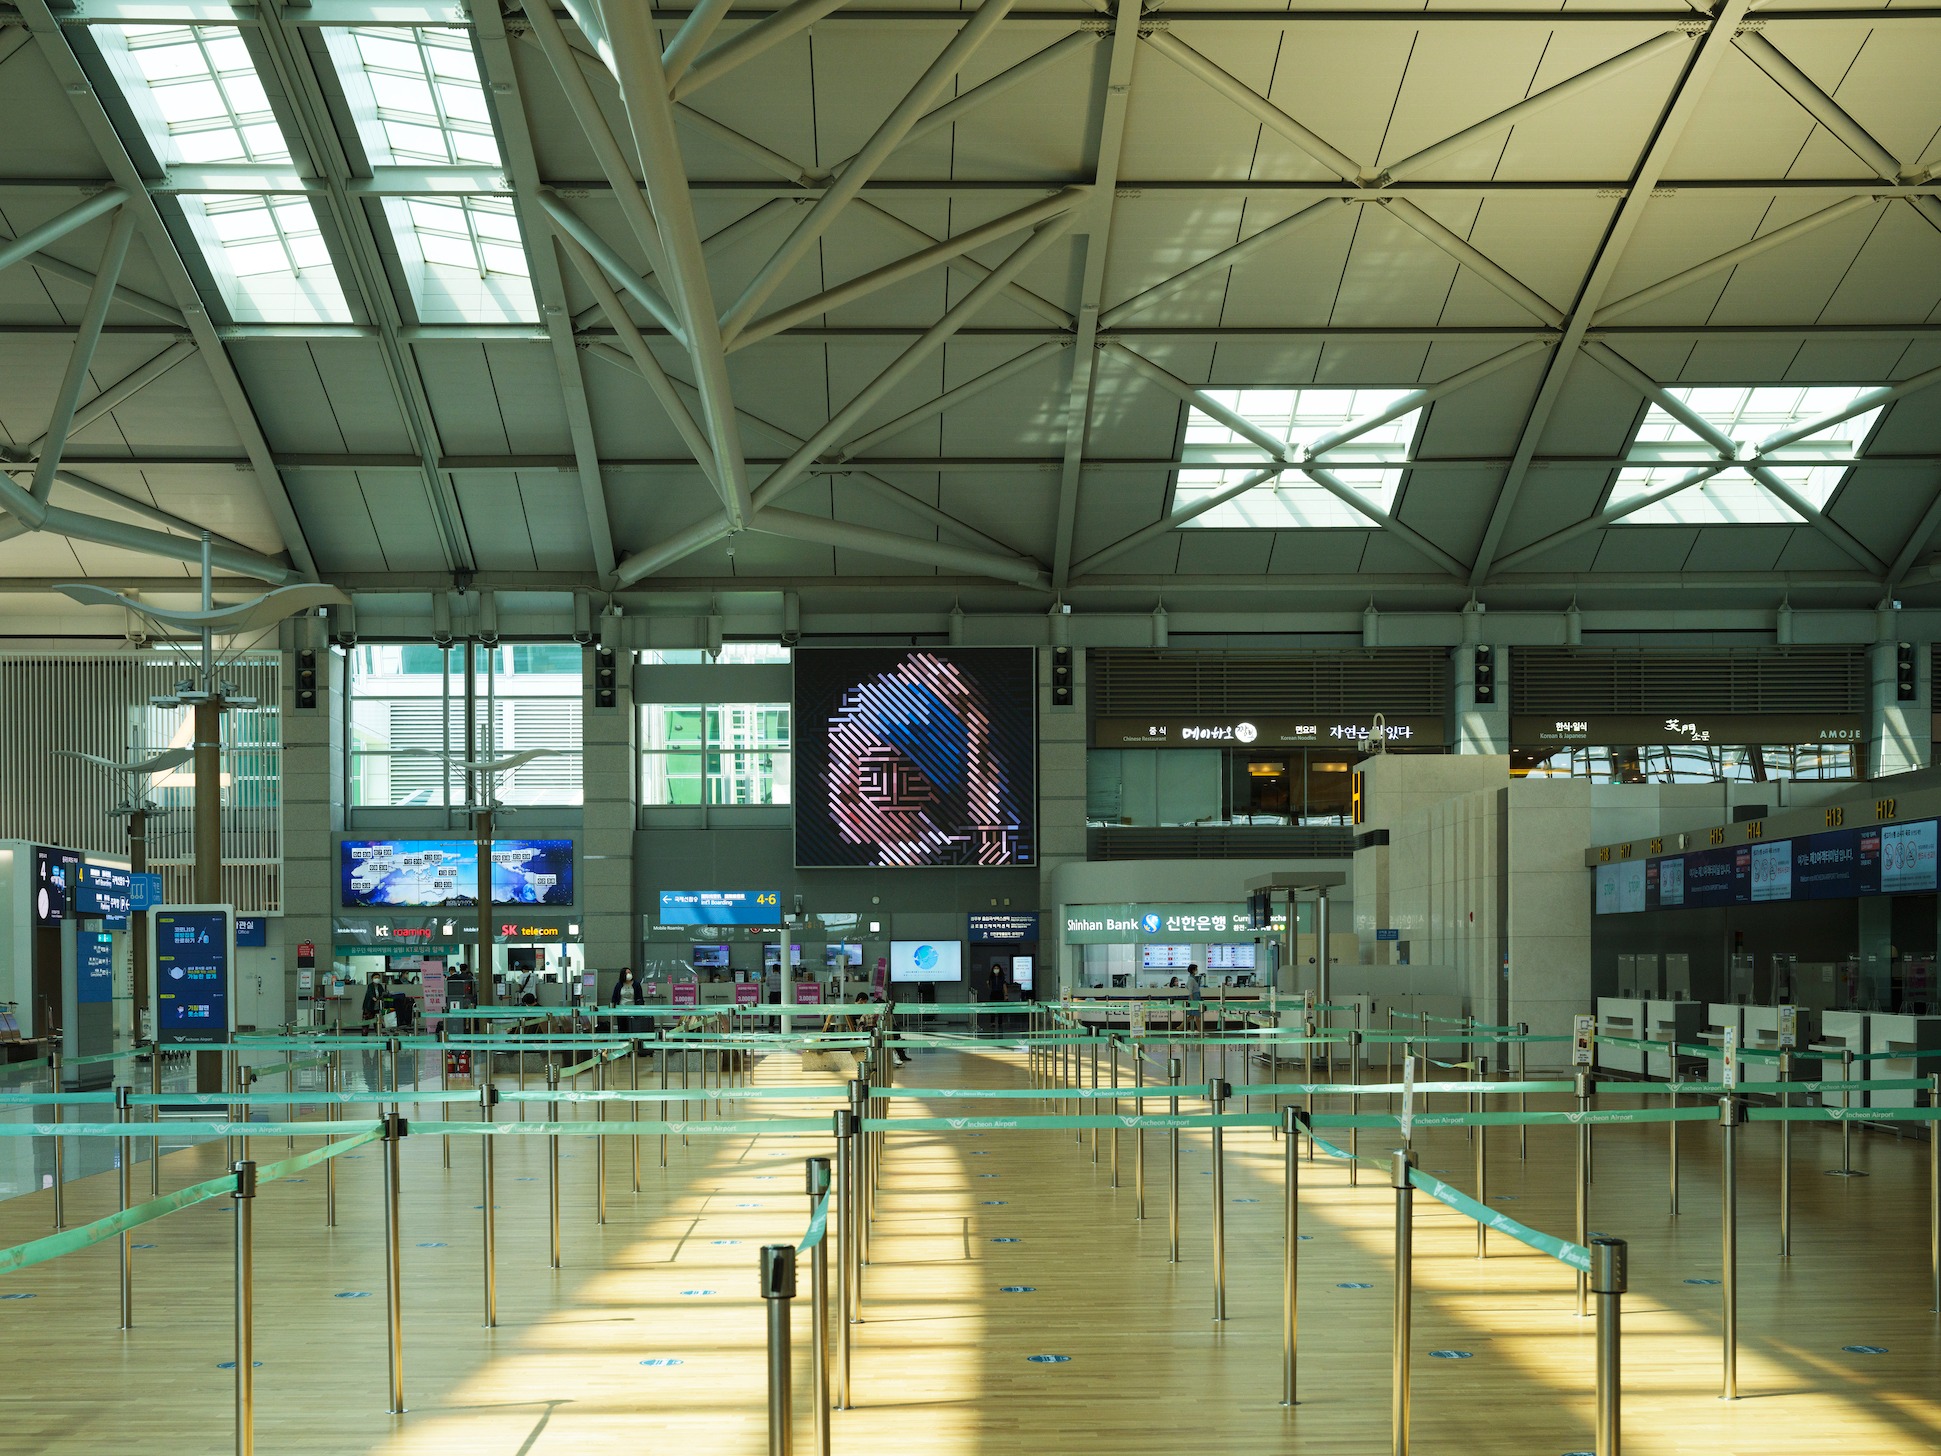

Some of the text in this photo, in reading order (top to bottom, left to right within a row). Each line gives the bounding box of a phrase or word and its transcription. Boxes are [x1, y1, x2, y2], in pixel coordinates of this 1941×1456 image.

[1330, 724, 1369, 740] 자연은
[1820, 730, 1861, 739] AMOJE
[1876, 799, 1895, 820] H12
[1826, 807, 1843, 827] H13
[1710, 828, 1724, 844] H15
[1747, 822, 1761, 839] H14
[1621, 844, 1631, 858] H17
[40, 861, 46, 881] 4
[756, 894, 776, 905] 4-6
[501, 924, 558, 936] SK telecom
[1067, 918, 1139, 931] Shinhan Bank
[1166, 915, 1226, 932] 신한은행
[376, 926, 431, 938] kt roaming
[1441, 1117, 1464, 1125] Airport
[1872, 1111, 1894, 1119] Airport
[83, 1126, 106, 1134] Airport
